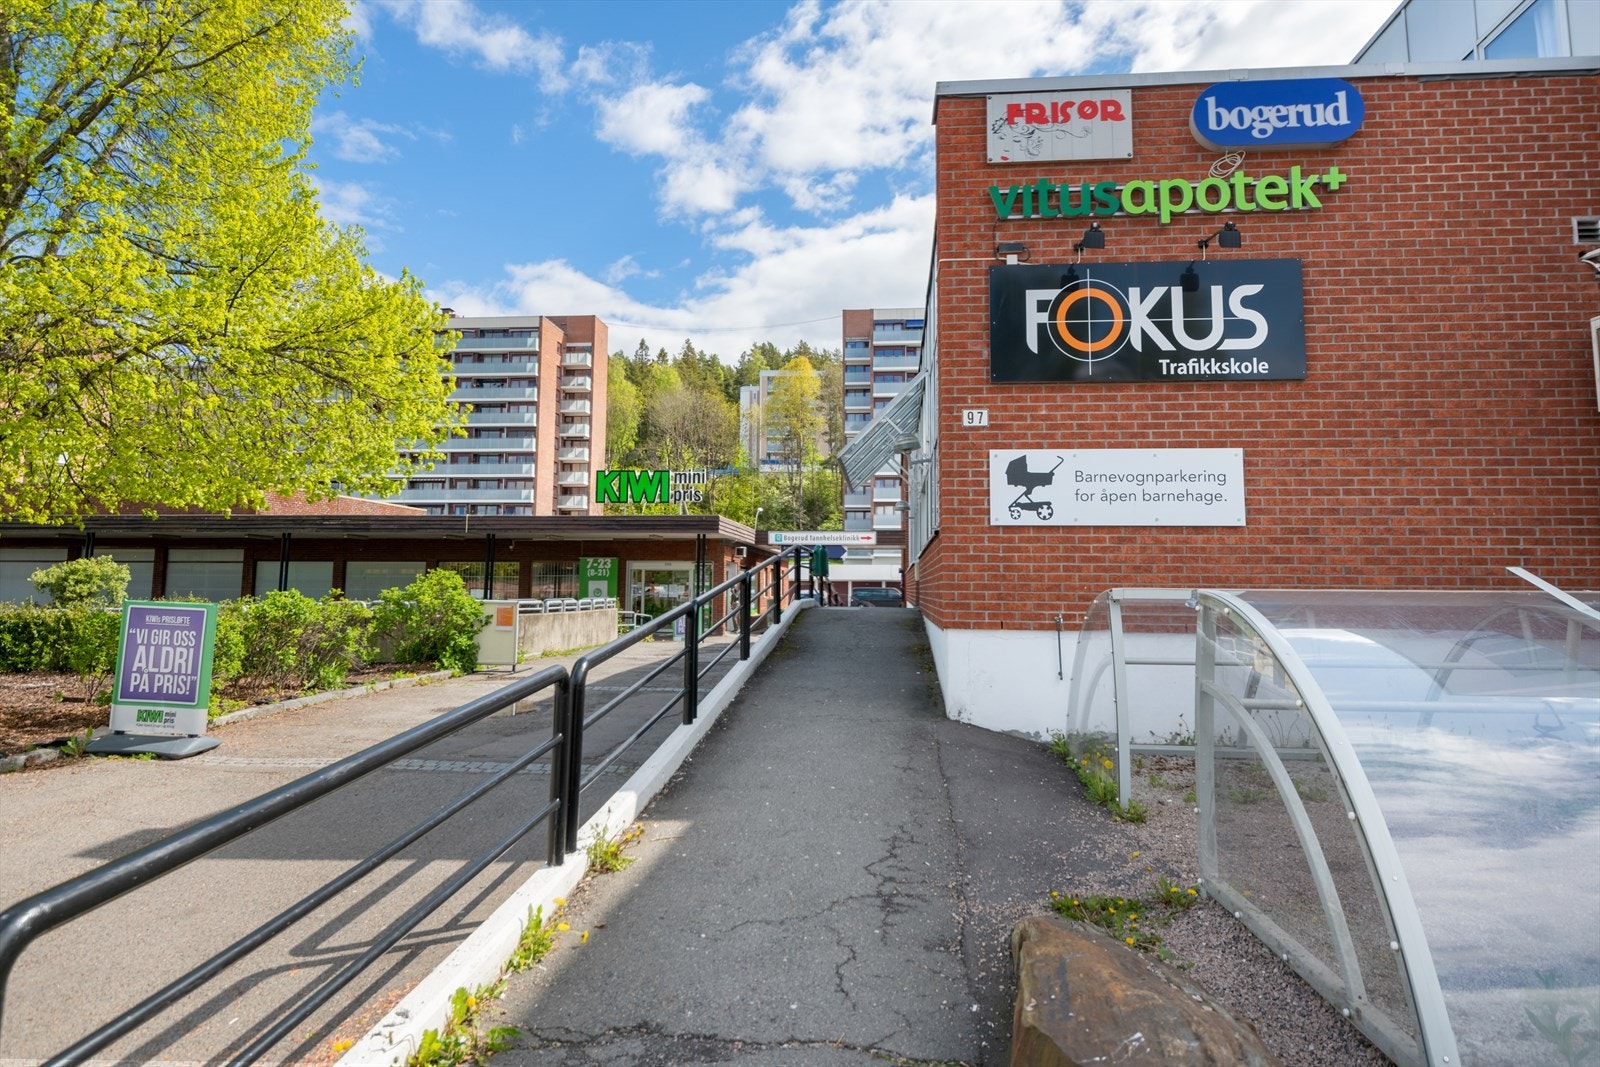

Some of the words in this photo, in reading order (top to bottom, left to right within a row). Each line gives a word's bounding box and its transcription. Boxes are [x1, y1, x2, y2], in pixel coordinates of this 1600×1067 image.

[1006, 98, 1126, 125] FRISØR
[1205, 90, 1351, 138] bogerud
[1025, 283, 1269, 354] FOKUS
[1159, 358, 1270, 376] Trafikkskole
[966, 411, 984, 425] 97
[673, 468, 707, 485] mini
[1074, 470, 1228, 486] Barnevognparkering
[595, 470, 671, 504] KIWI
[673, 487, 703, 505] pris
[1074, 489, 1096, 503] for
[1101, 488, 1138, 506] åpen
[1142, 488, 1229, 505] barnehage.
[783, 534, 809, 542] Bogerud
[585, 558, 612, 570] 7-23
[150, 629, 171, 646] GIR
[173, 630, 196, 647] OSS
[132, 645, 195, 674] ALDRI
[129, 667, 150, 693] PÅ
[136, 709, 164, 722] KIWI
[163, 716, 175, 725] pris
[164, 710, 177, 718] mini
